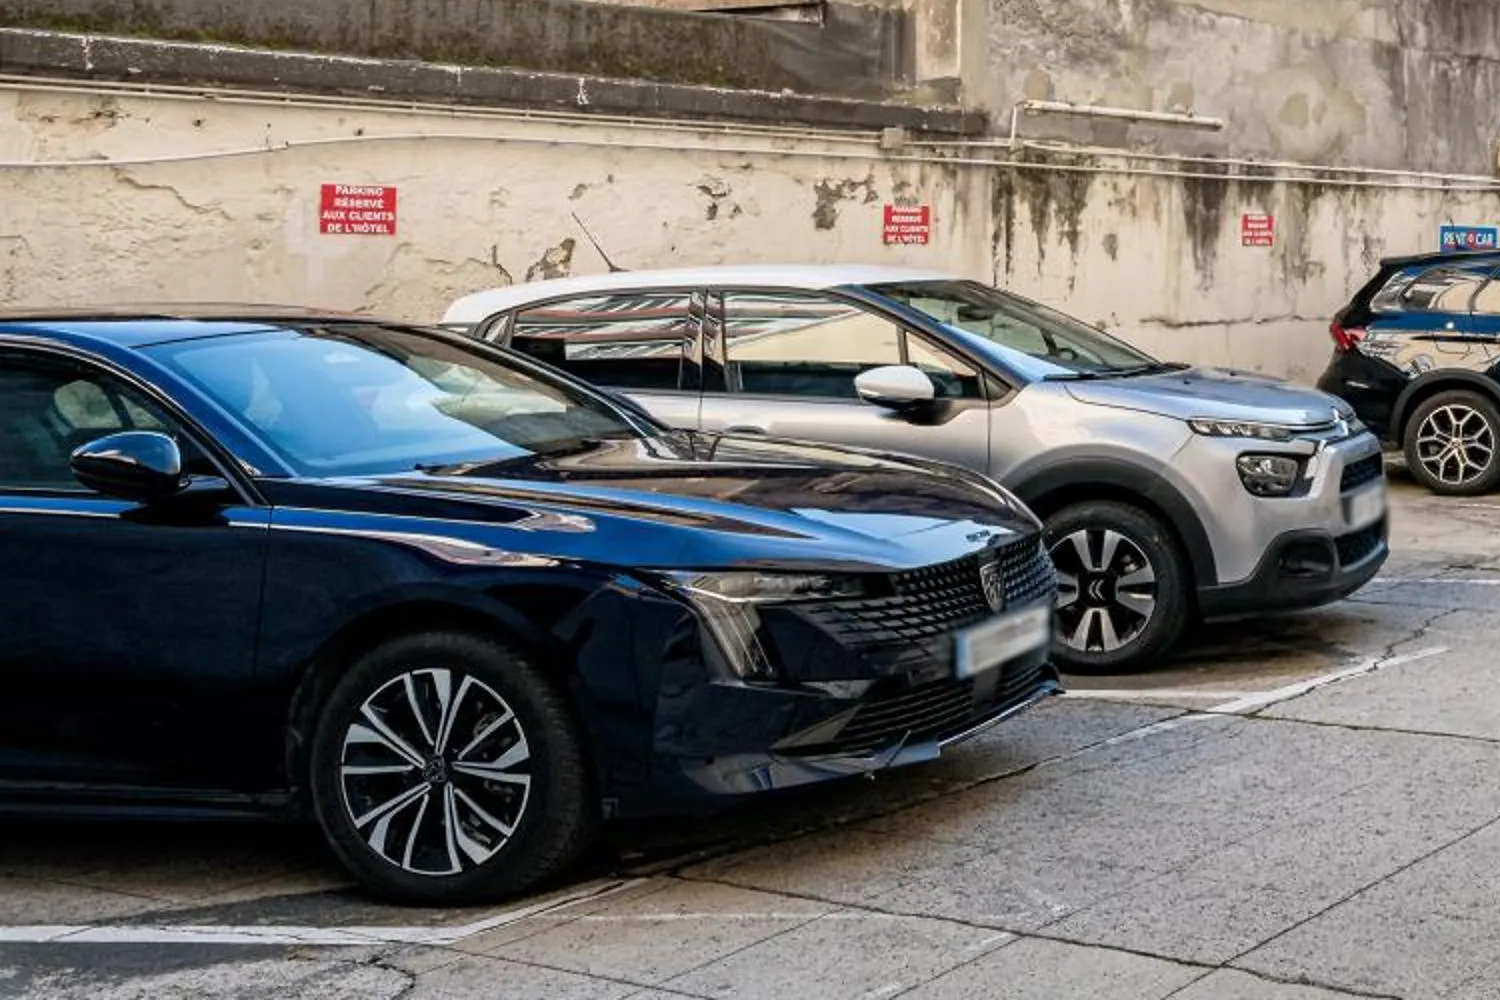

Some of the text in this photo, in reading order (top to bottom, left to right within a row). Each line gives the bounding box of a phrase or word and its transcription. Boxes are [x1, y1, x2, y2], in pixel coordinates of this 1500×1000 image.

[335, 186, 384, 196] PARKING
[334, 198, 384, 209] RÉSERVÉ
[322, 210, 394, 221] AUX CLIENTS
[327, 222, 389, 233] DE L'HÔTEL
[1443, 231, 1466, 245] RENT
[1476, 233, 1493, 246] CAR
